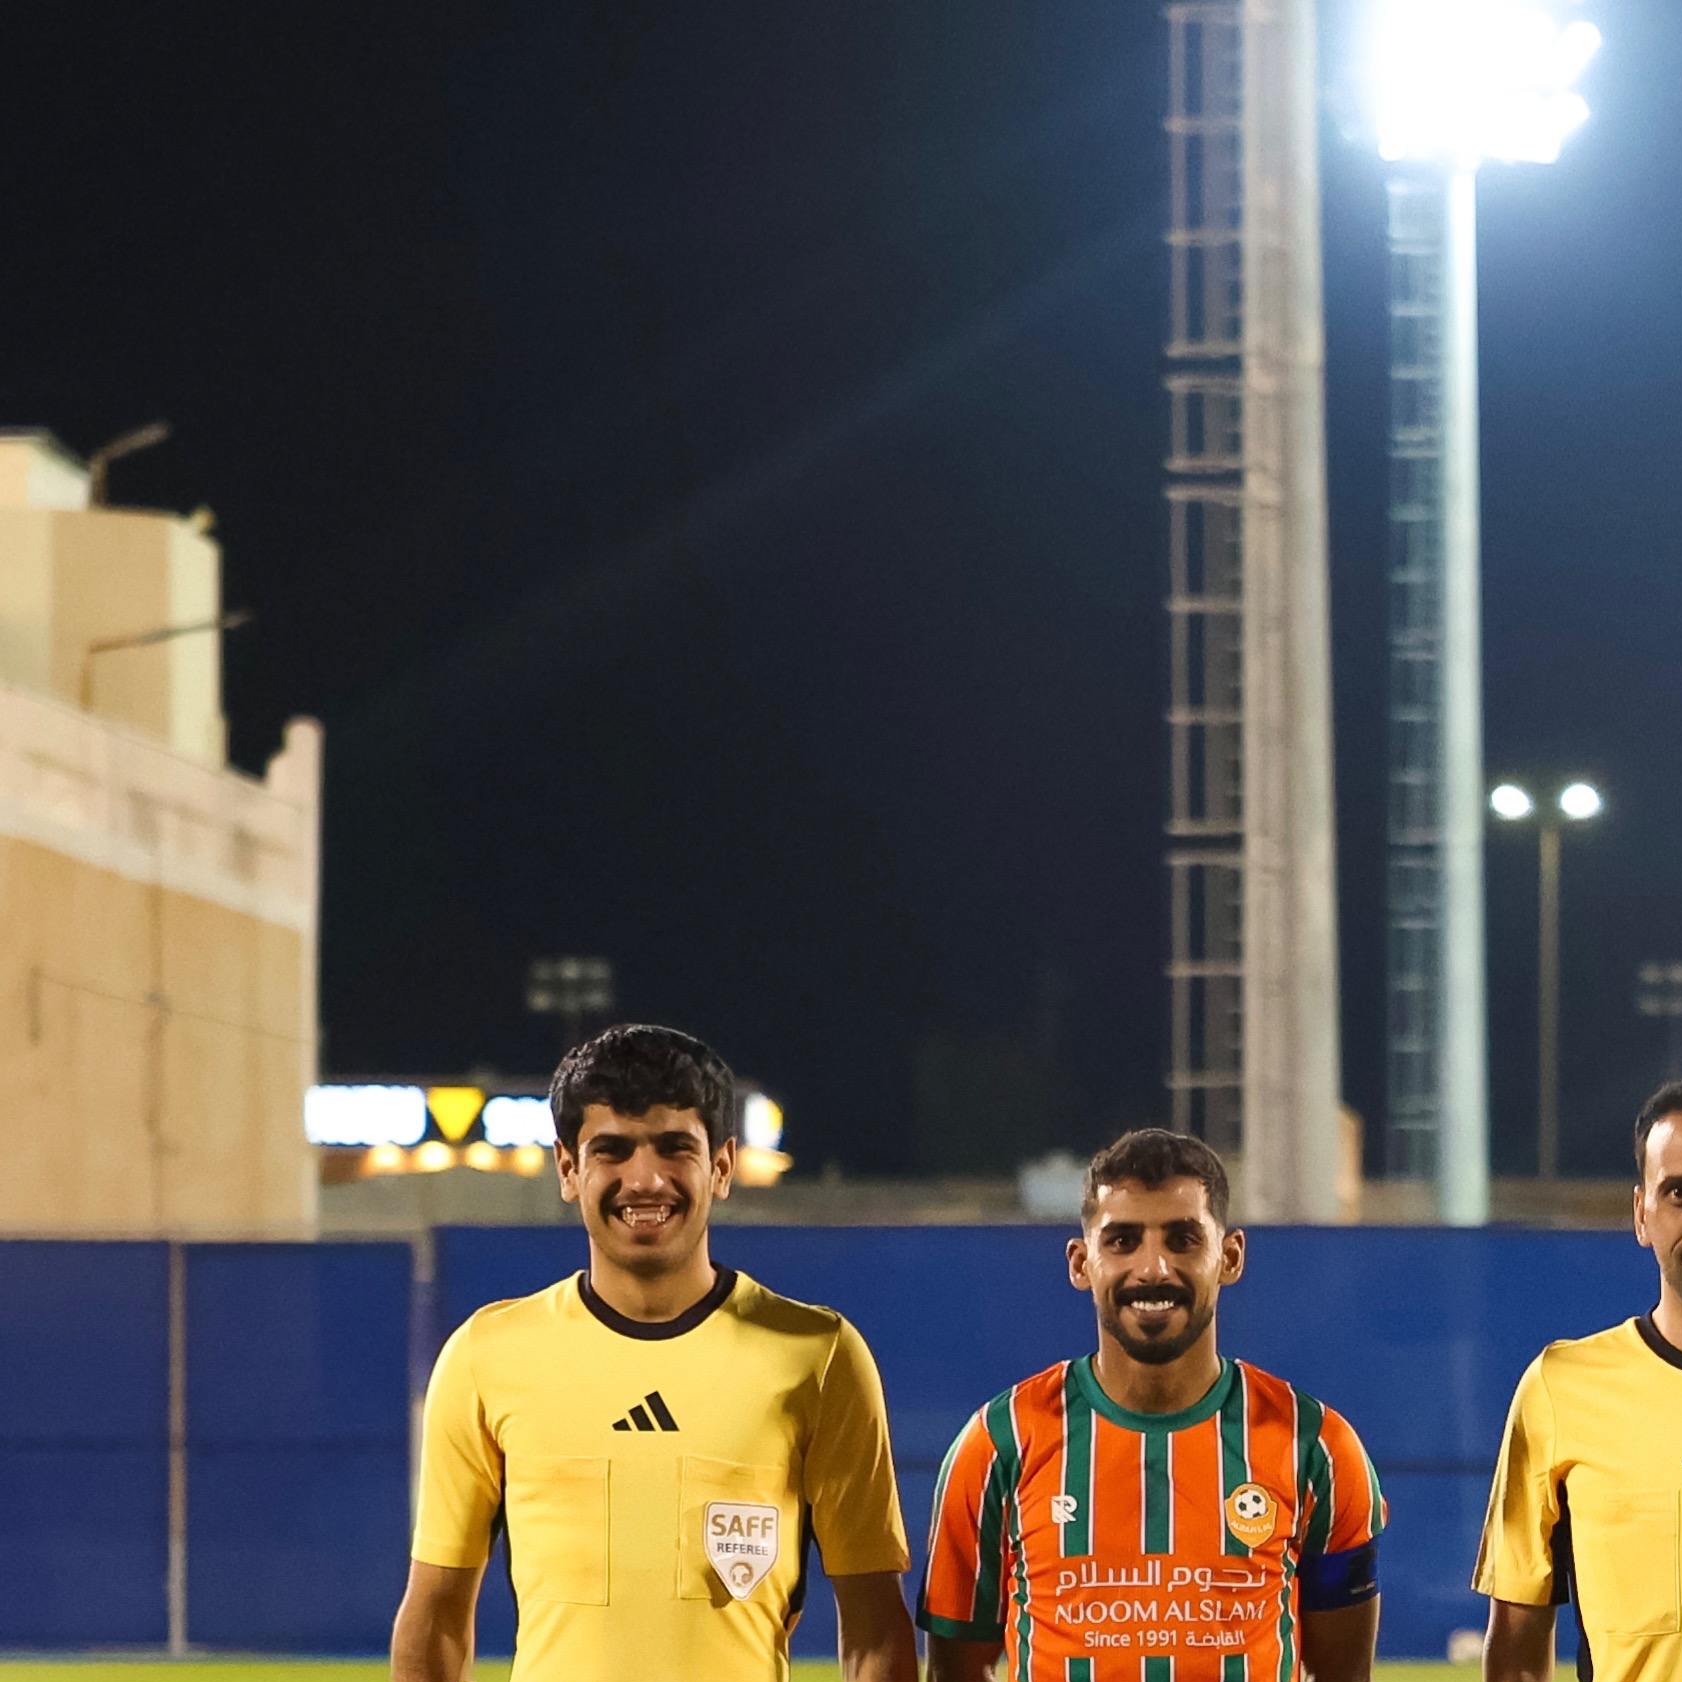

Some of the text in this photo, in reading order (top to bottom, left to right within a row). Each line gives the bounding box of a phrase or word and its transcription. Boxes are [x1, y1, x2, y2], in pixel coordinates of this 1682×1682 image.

[711, 1513, 774, 1538] SAFF
[717, 1542, 768, 1556] REFEREE
[1055, 1560, 1266, 1597] نجوم السلام
[1055, 1599, 1266, 1625] NJOOM ALSLAM
[1084, 1630, 1177, 1647] Since 1991
[1186, 1630, 1245, 1649] القابضة
